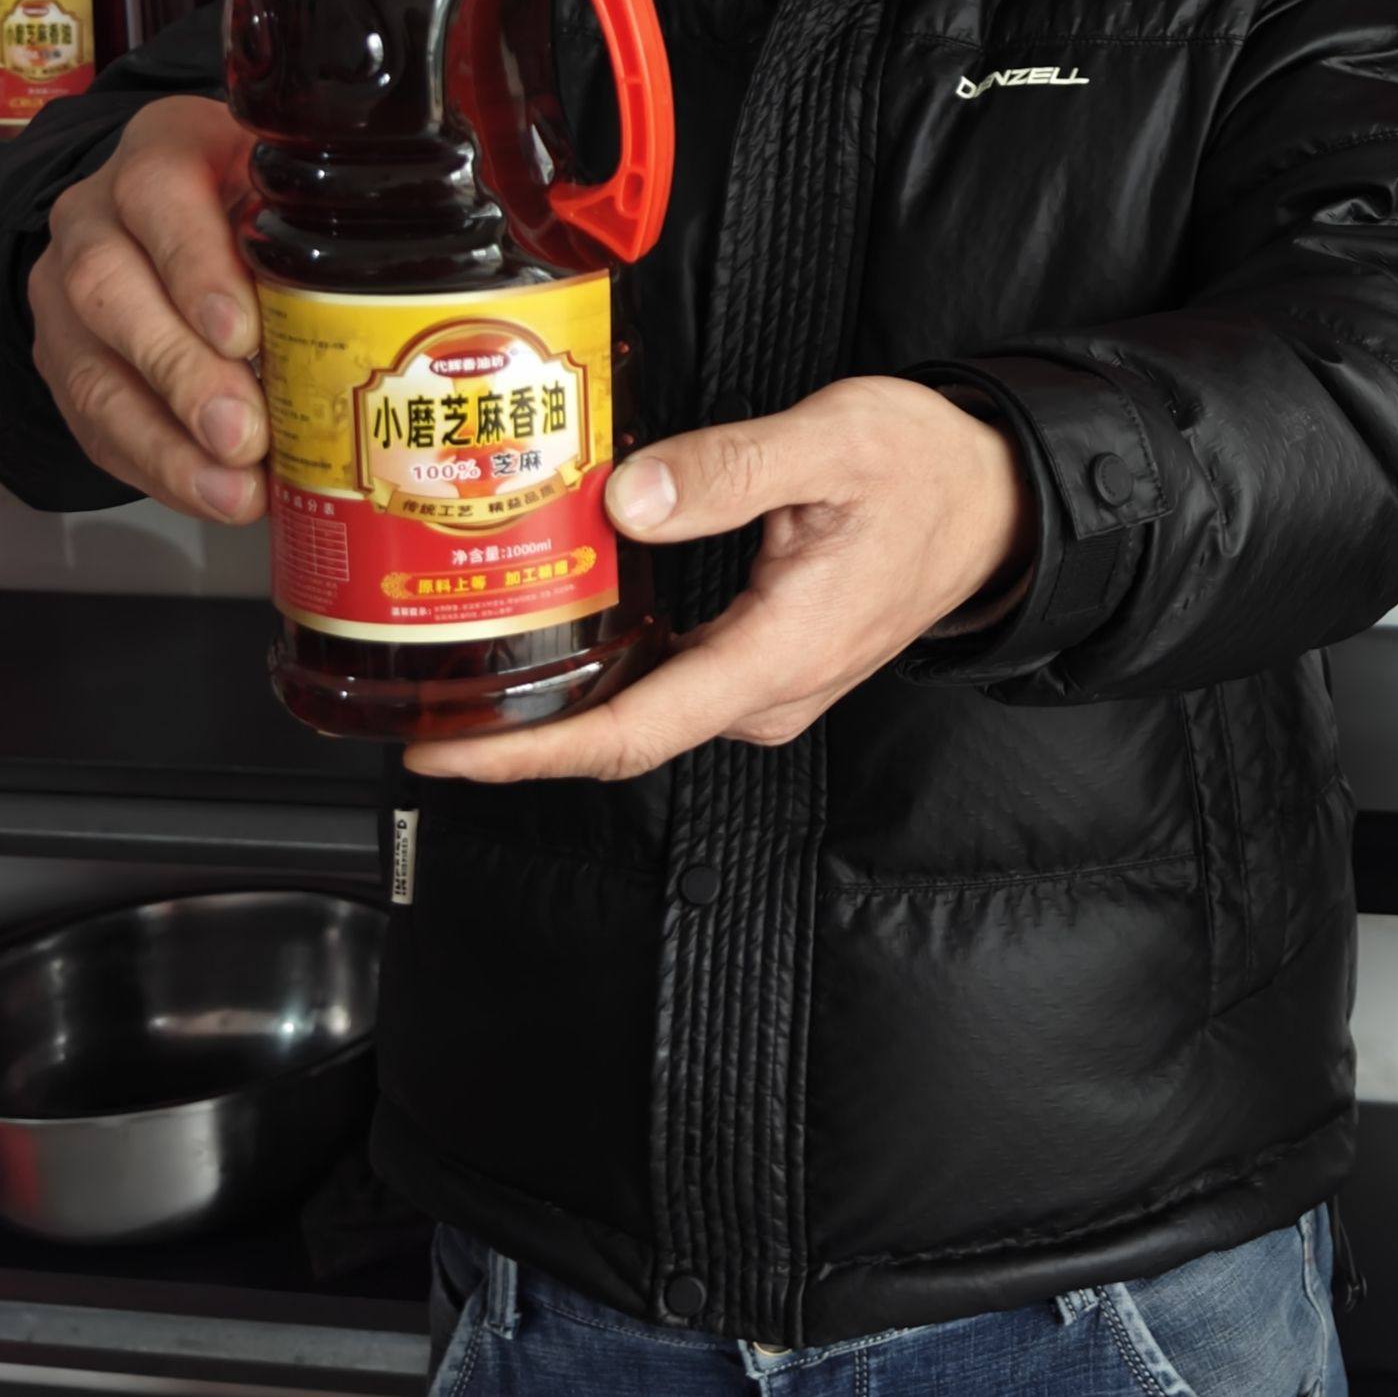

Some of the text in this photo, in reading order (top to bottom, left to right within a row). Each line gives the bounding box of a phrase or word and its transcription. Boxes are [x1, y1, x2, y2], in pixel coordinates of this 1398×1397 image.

[373, 380, 567, 449] 小磨芝麻香油
[413, 450, 543, 481] 100% 芝麻
[418, 574, 487, 595] 原料上等
